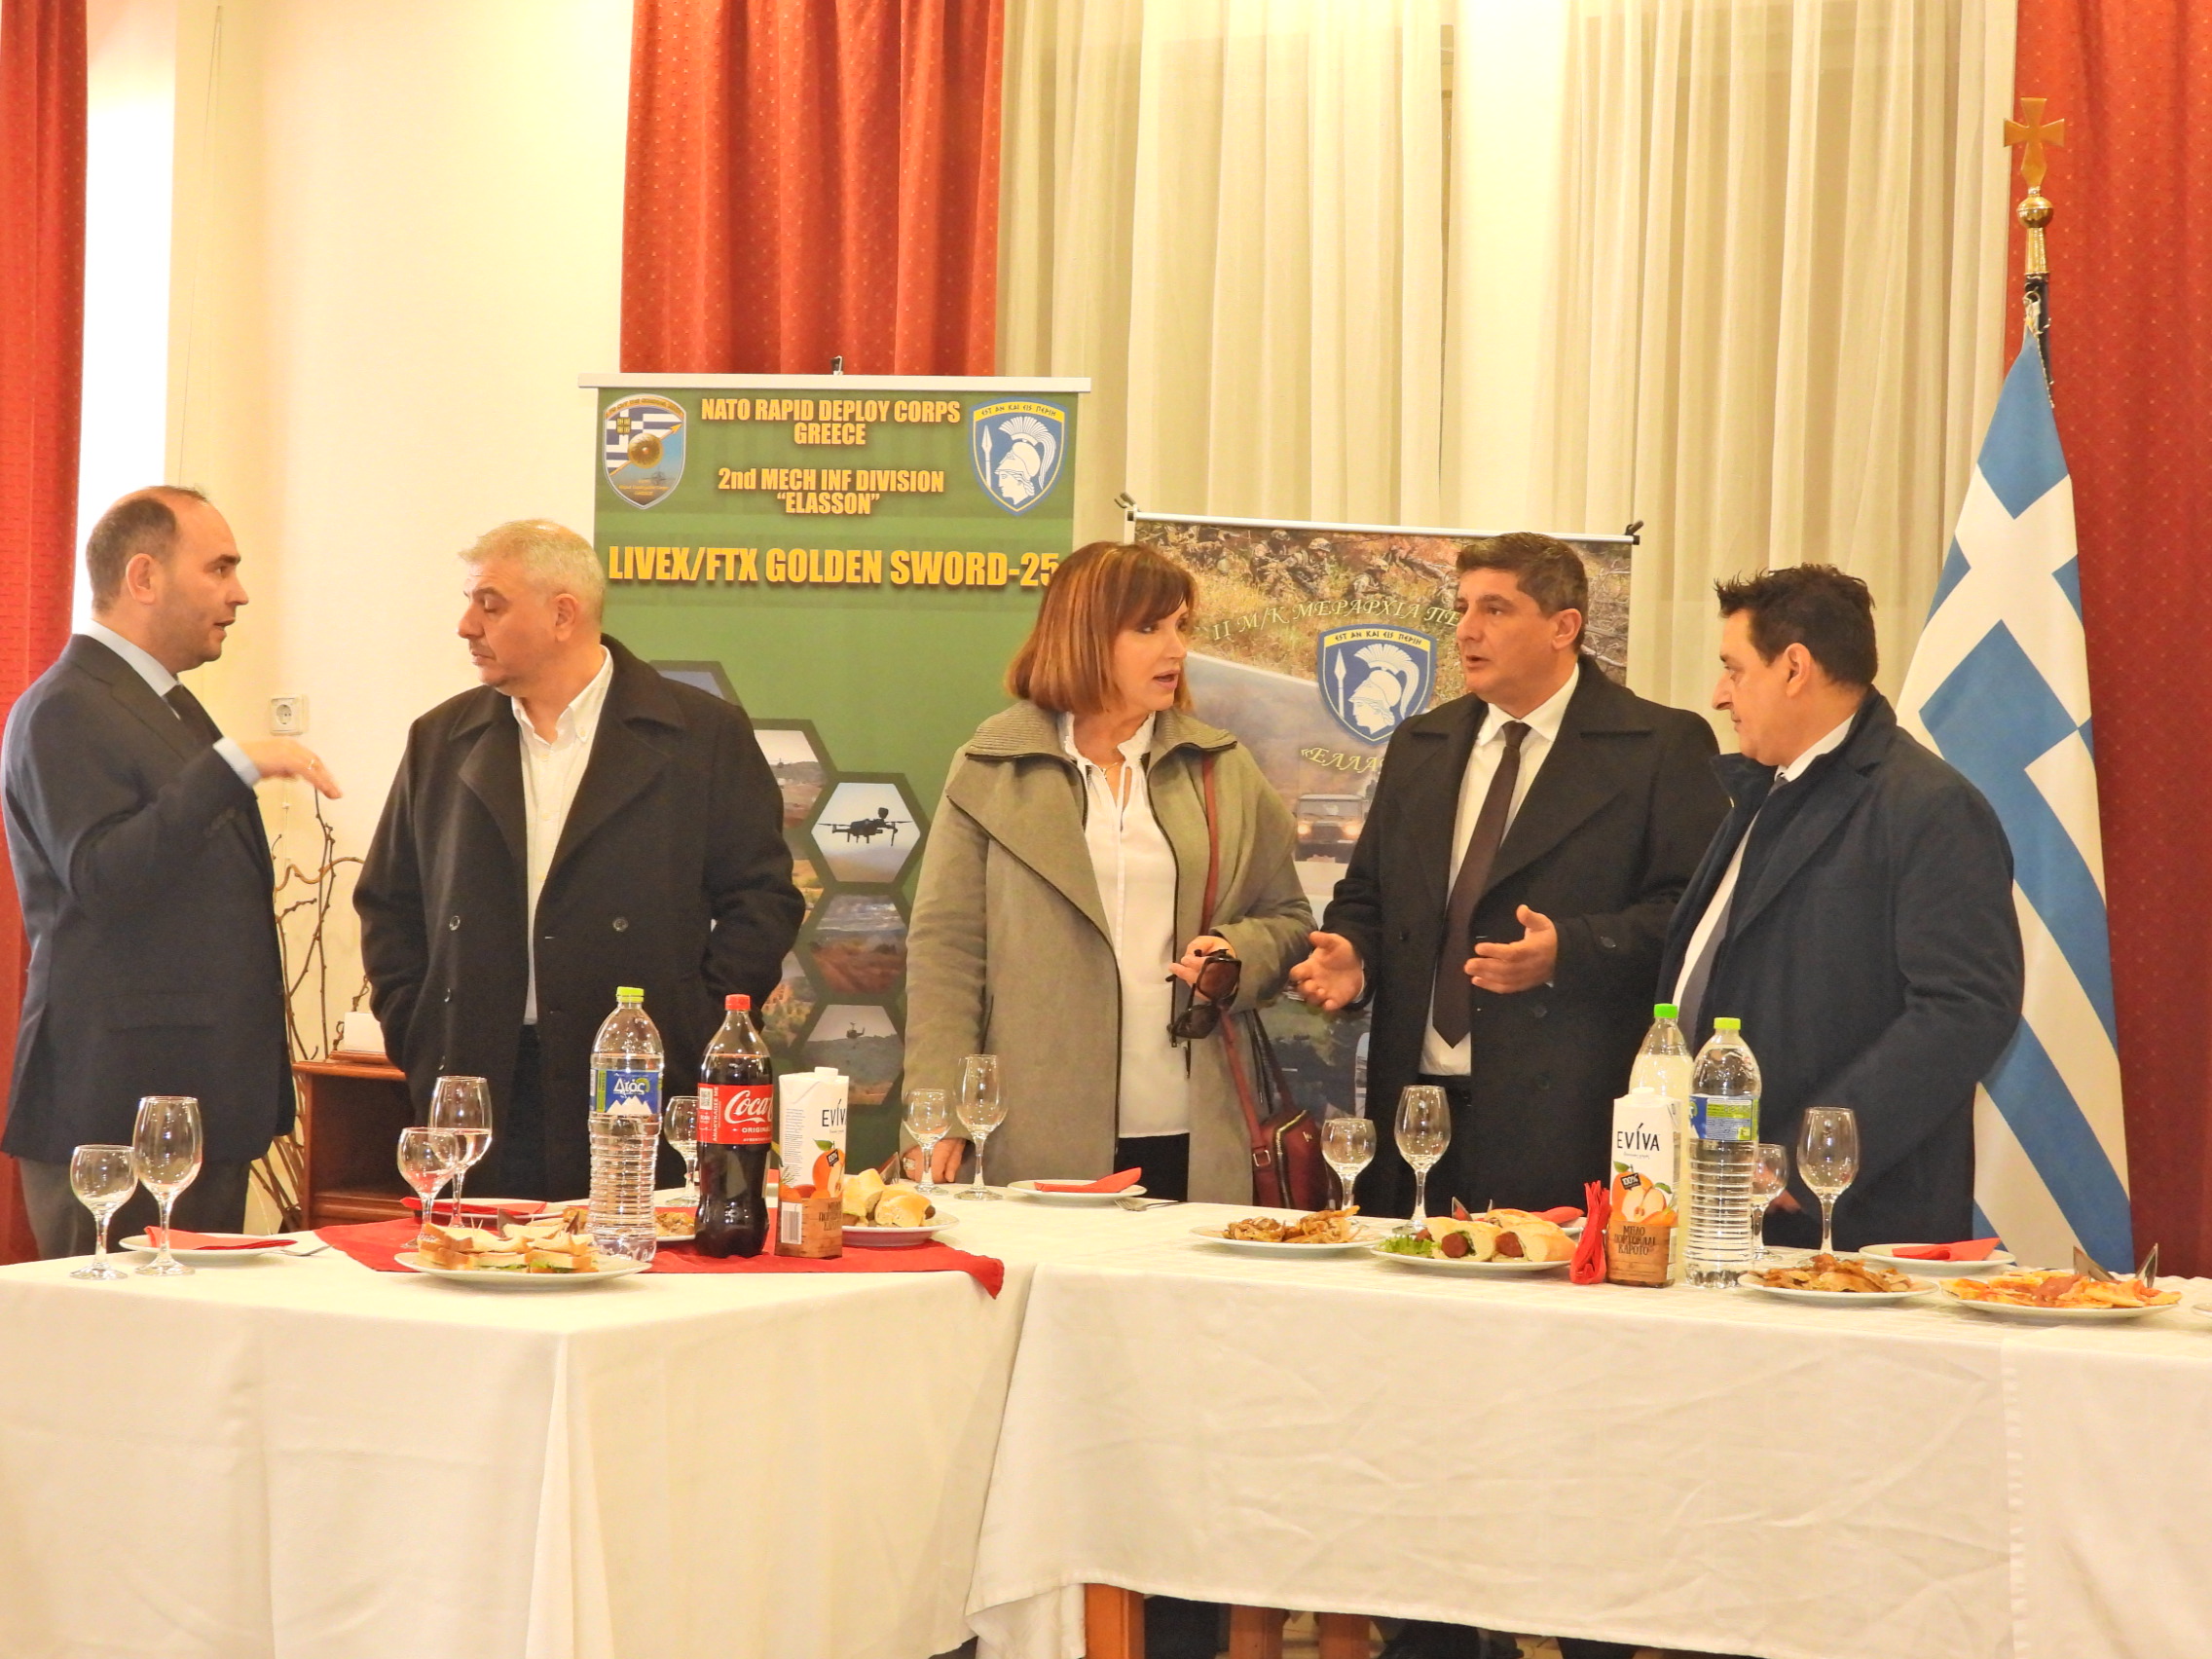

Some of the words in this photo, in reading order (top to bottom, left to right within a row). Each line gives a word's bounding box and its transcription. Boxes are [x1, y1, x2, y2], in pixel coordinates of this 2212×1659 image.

[701, 398, 751, 421] NATO
[755, 399, 814, 421] RAPID
[819, 400, 890, 422] DEPLOY
[894, 400, 961, 424] CORPS
[793, 423, 866, 445] GREECE
[718, 467, 756, 490] 2nd
[760, 468, 816, 491] MECH
[821, 469, 852, 491] INF
[856, 470, 944, 492] DIVISION
[777, 492, 880, 515] “ELASSON”
[608, 545, 758, 581] LIVEX/FTX
[765, 547, 882, 583] GOLDEN
[890, 550, 1059, 587] SWORD-25
[1292, 599, 1420, 621] ΜΕΡΑΡΧΙΑ
[1423, 607, 1460, 626] ΠΕ
[1301, 747, 1383, 774] «ΕΛΛΑ
[822, 1098, 847, 1127] EVÍV
